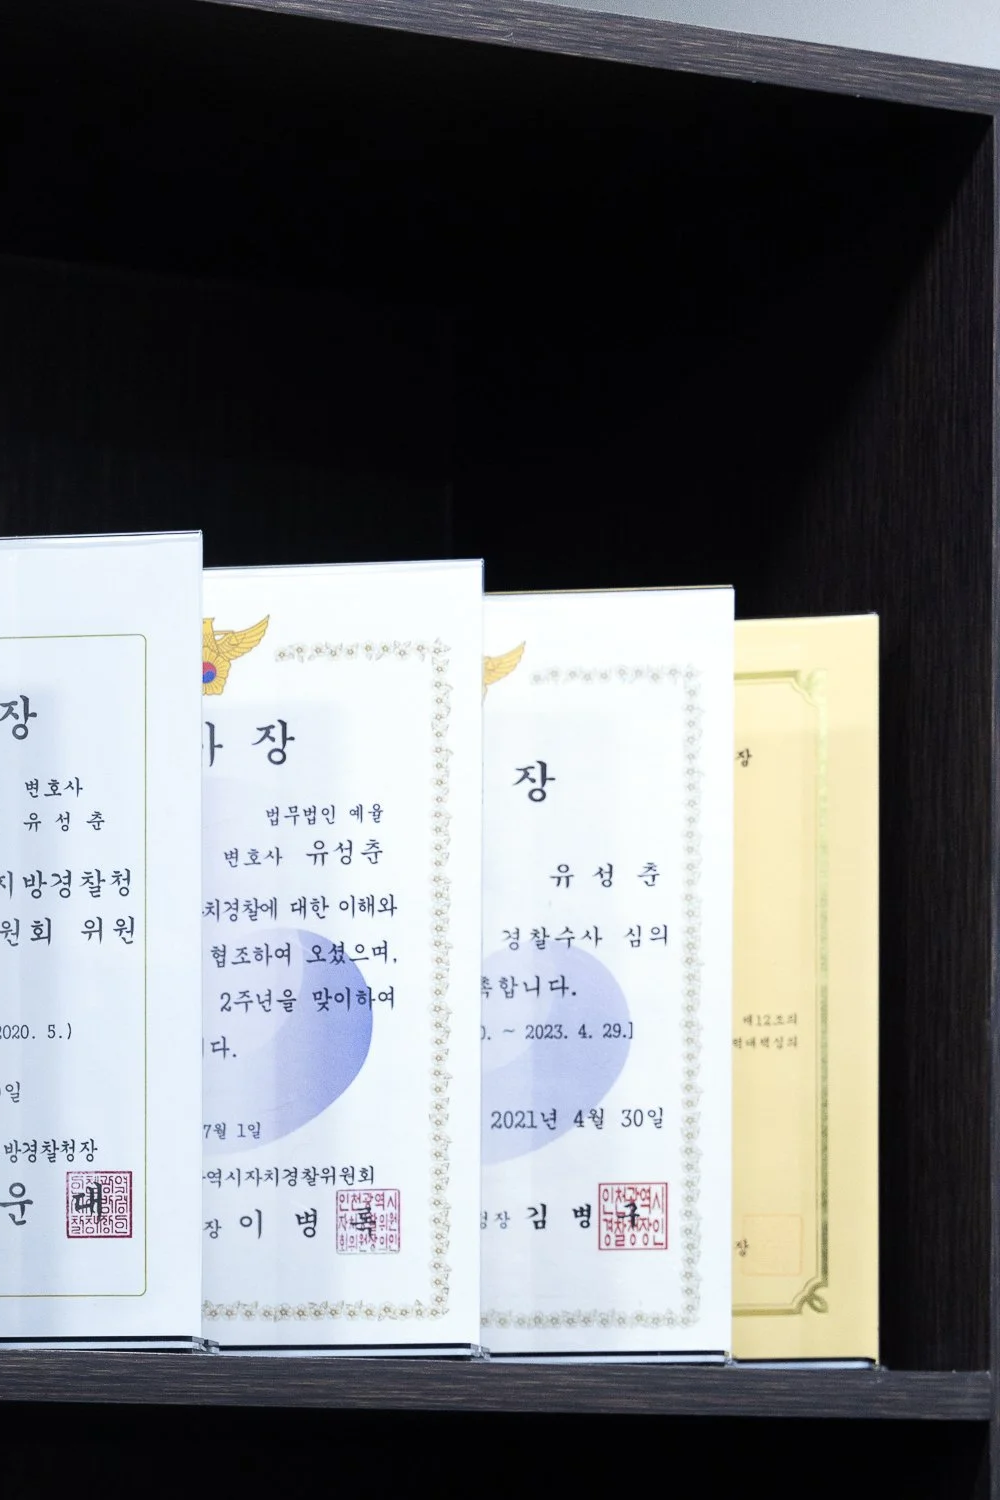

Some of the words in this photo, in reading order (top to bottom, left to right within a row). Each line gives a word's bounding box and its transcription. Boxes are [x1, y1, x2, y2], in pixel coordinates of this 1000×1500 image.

[253, 720, 295, 765] 장
[25, 777, 83, 798] 변호사
[512, 761, 555, 802] 장
[266, 805, 334, 826] 법무법인
[350, 804, 383, 823] 예율
[224, 847, 282, 867] 변호사
[306, 840, 382, 866] 유성춘
[291, 896, 329, 919] 대한
[339, 894, 397, 917] 이해와
[81, 916, 134, 944] 위원
[504, 926, 602, 950] 경찰수사
[627, 925, 667, 947] 심의
[211, 943, 290, 968] 협조하여
[306, 940, 396, 965] 오셨으며,
[221, 989, 296, 1012] 2주년을
[312, 982, 393, 1012] 맞이하여
[48, 1023, 71, 1039] 5.)
[526, 1024, 567, 1039] 2023.
[578, 1024, 592, 1038] 4.
[603, 1022, 632, 1039] 29.]
[204, 1123, 226, 1139] 7월
[238, 1122, 260, 1139] 1일
[491, 1108, 556, 1130] 2021년
[573, 1108, 603, 1129] 4월
[621, 1108, 663, 1128] 30일
[240, 1209, 261, 1238] 이
[296, 1208, 317, 1238] 병
[528, 1204, 546, 1229] 김
[573, 1204, 591, 1228] 병
